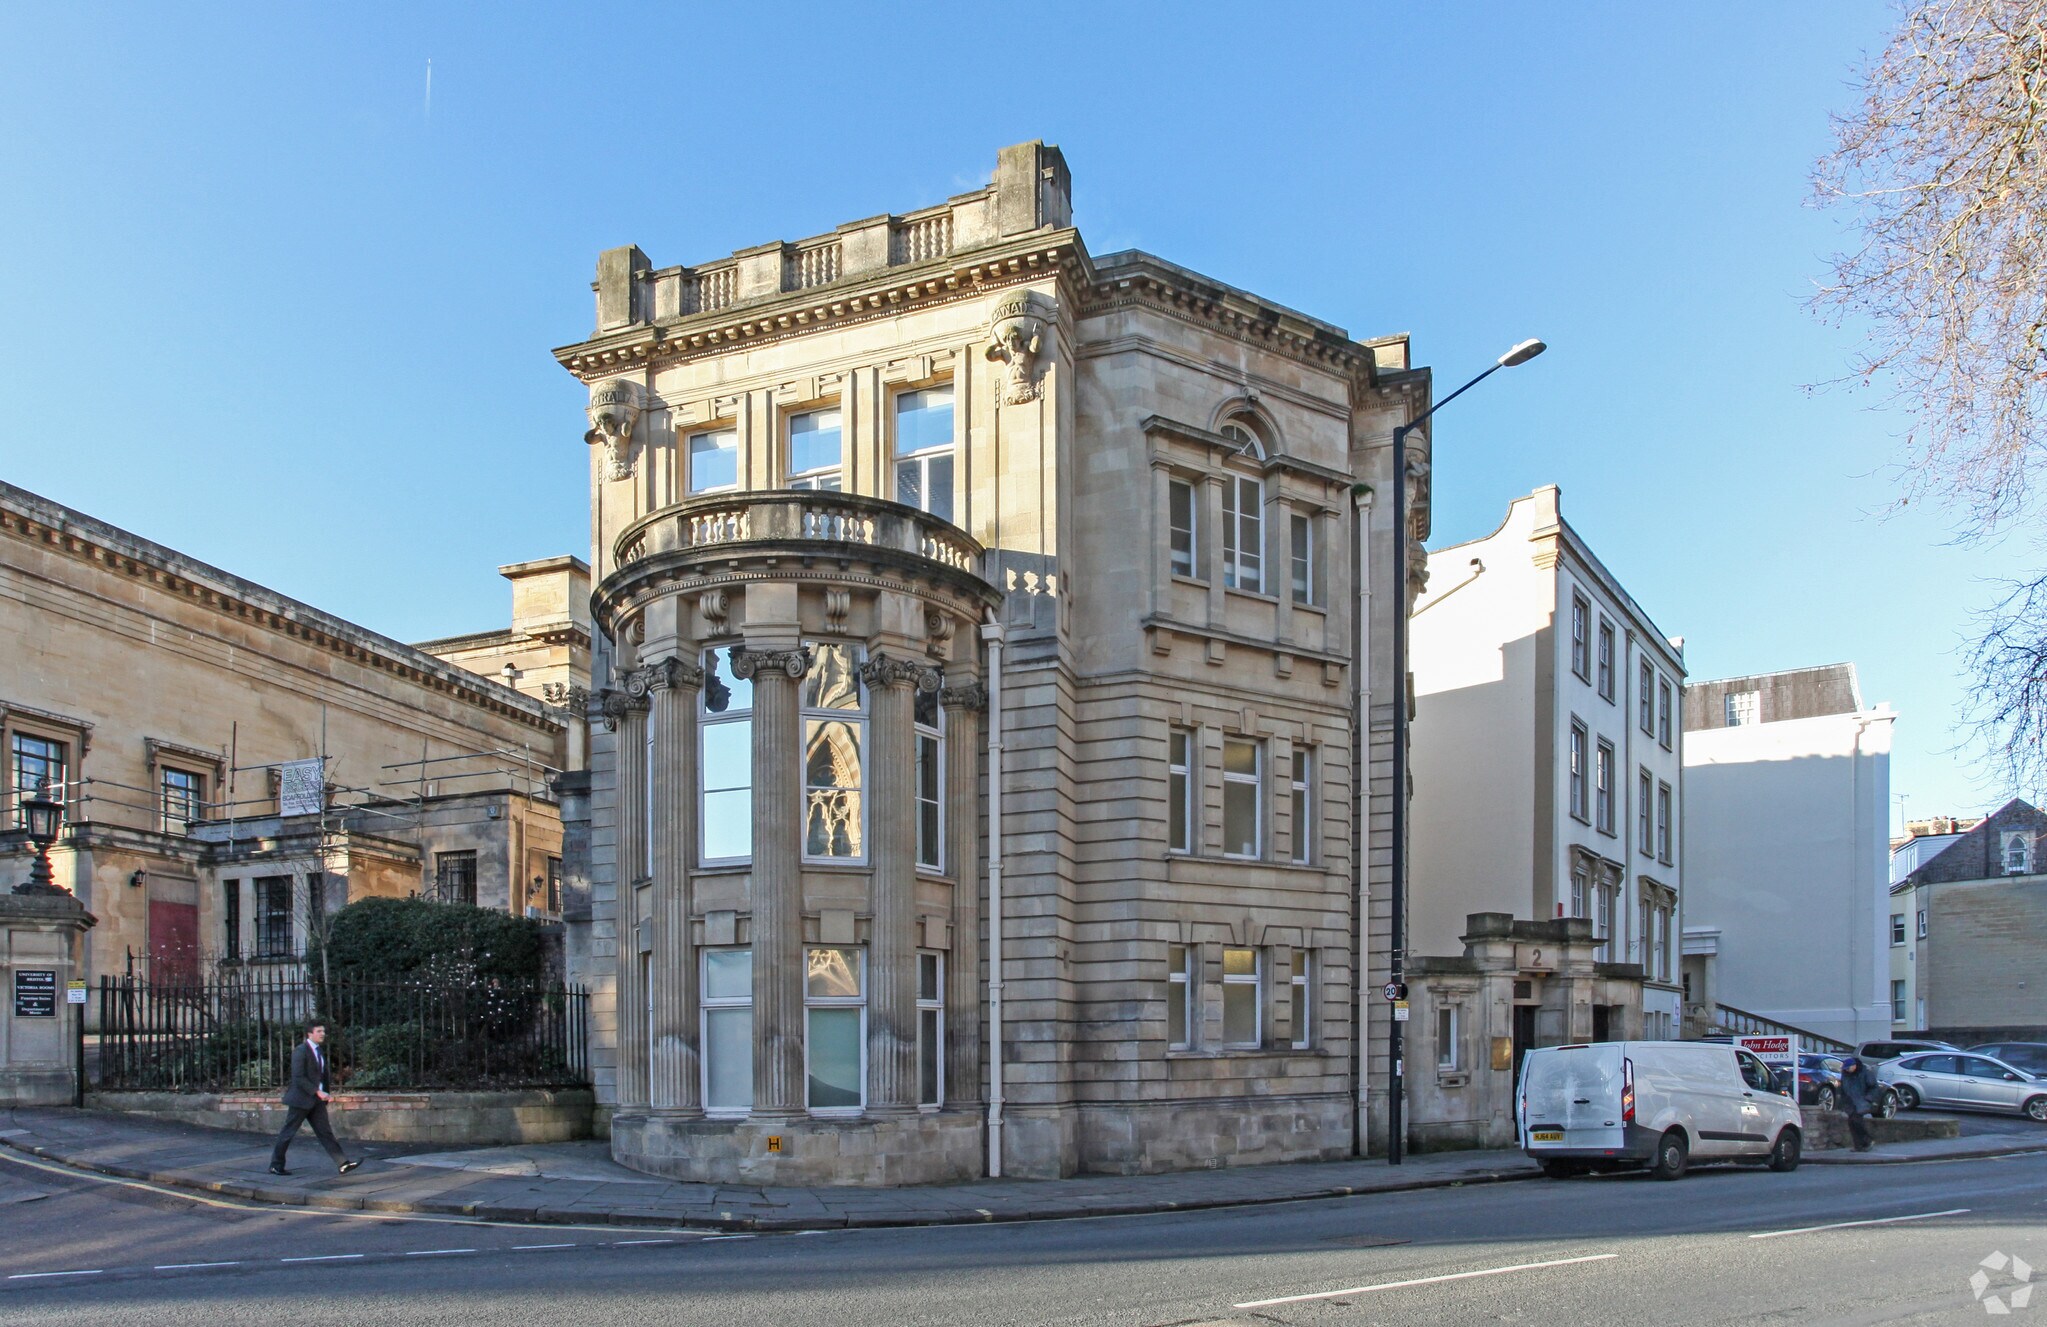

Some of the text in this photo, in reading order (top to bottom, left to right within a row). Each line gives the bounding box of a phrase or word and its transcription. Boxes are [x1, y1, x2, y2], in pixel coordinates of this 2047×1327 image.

[283, 766, 320, 782] EASY
[1533, 949, 1542, 966] 2
[1386, 987, 1396, 995] 20
[1743, 1039, 1788, 1051] John Hodge
[769, 1138, 779, 1150] H
